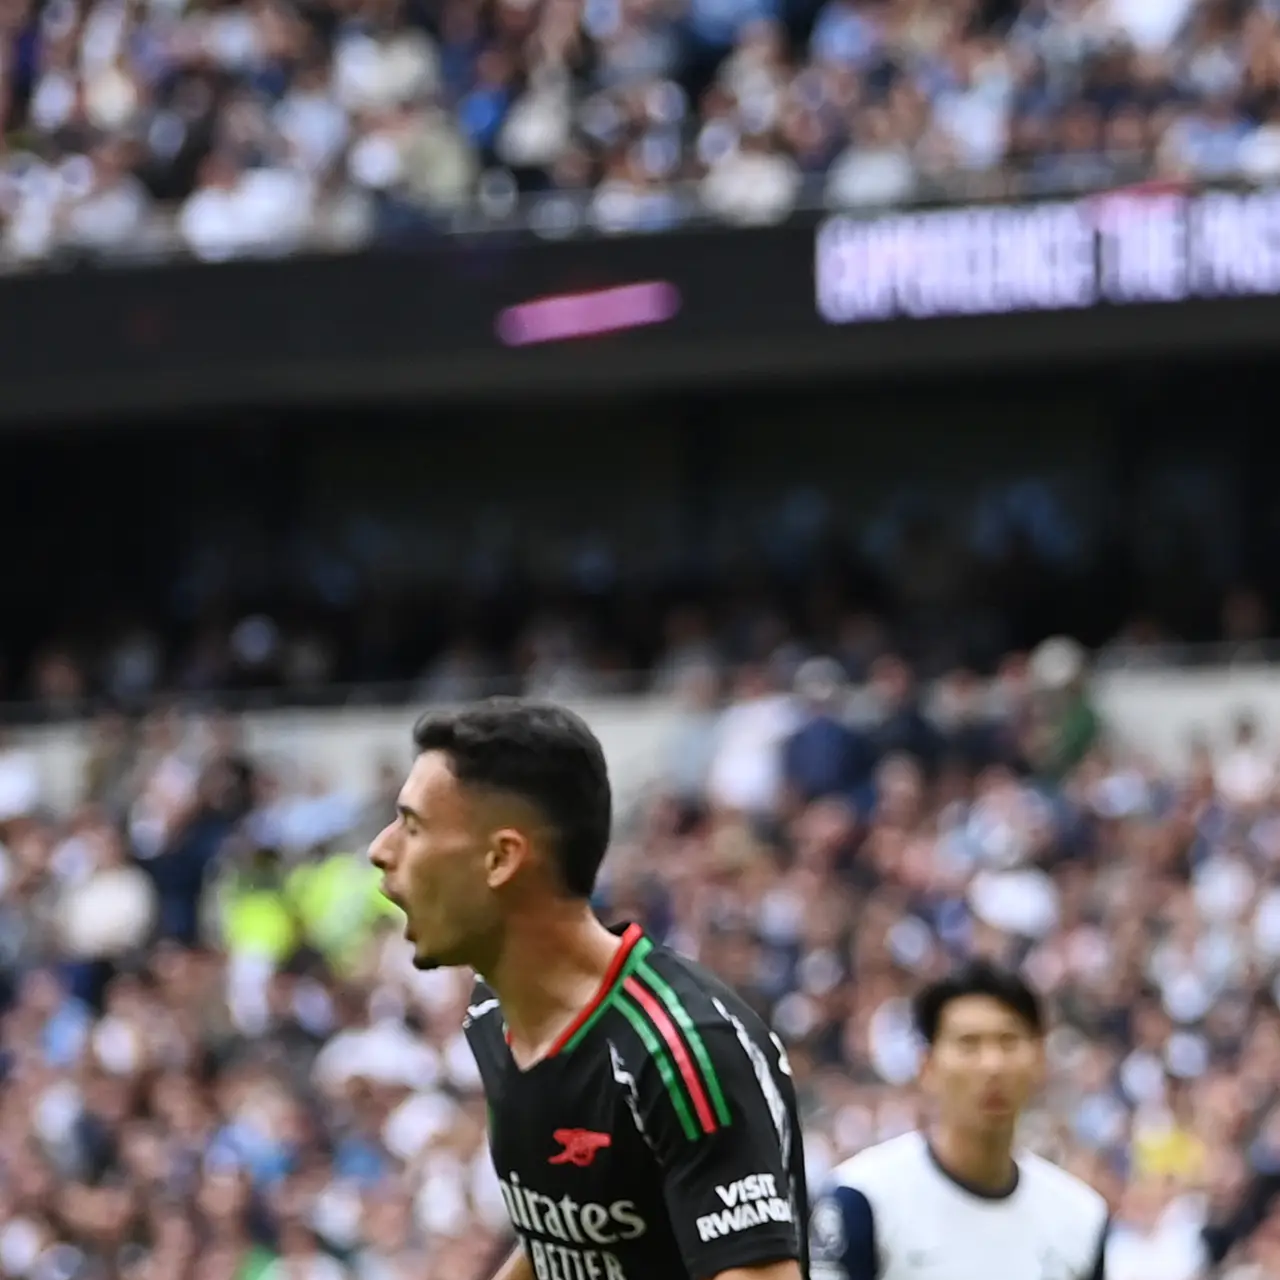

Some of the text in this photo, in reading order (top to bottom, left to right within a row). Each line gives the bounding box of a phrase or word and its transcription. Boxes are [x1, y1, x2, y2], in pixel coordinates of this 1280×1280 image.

[500, 1171, 647, 1245] irates
[716, 1173, 776, 1208] VISIT
[696, 1197, 793, 1242] RWAND
